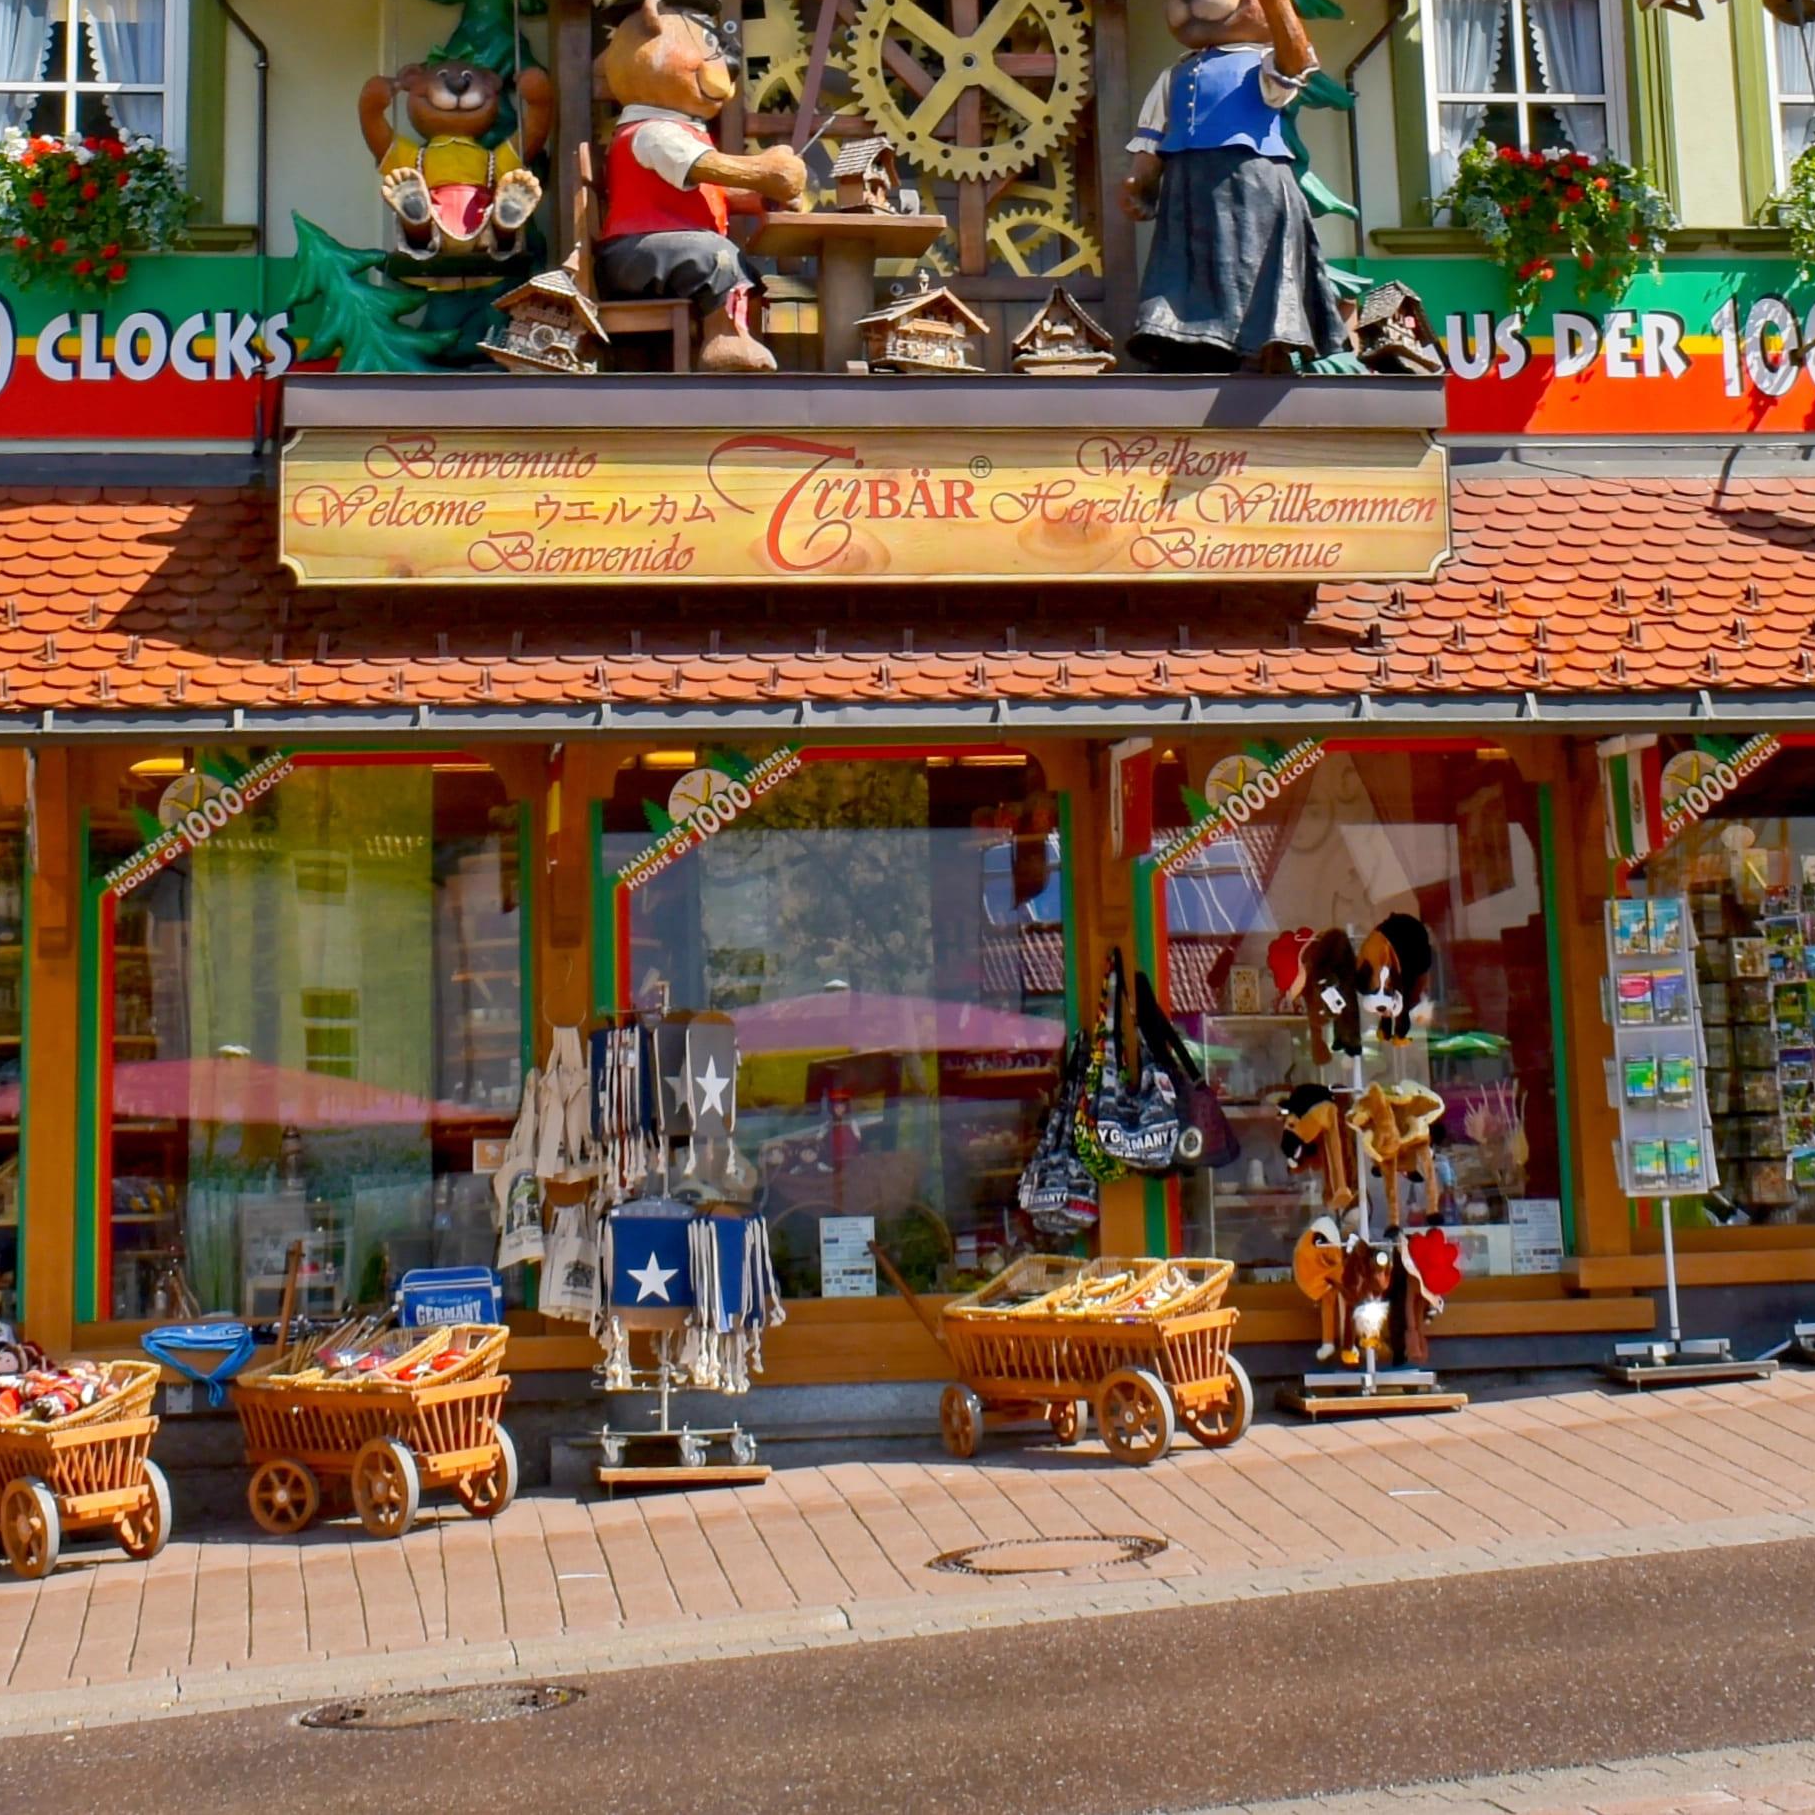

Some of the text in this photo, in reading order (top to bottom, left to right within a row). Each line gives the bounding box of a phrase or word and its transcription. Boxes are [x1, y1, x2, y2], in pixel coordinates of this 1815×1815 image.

[35, 311, 292, 381] CLOCKS
[1444, 312, 1527, 380] US
[1552, 312, 1687, 379] DER
[364, 434, 598, 480] Benvenuto
[1076, 435, 1248, 478] Welkom
[292, 484, 486, 528] Welcome
[990, 478, 1436, 525] Herzlich Willkommen
[467, 530, 695, 574] Bienvenido
[1129, 526, 1343, 570] Bienvenue
[104, 751, 283, 884] HAUS DER 1000 UHREN
[617, 746, 792, 879] HAUS DER 1000 UHREN
[1154, 737, 1316, 866] HAUS DER 1000 UHREN
[1162, 746, 1326, 878] HOUSE OF CLOCKS
[1669, 739, 1782, 832] OF CLOCKS
[1678, 762, 1739, 821] 1000
[113, 761, 295, 897] HOUSE OF CLOCKS
[626, 756, 802, 890] HOUSE OF CLOCKS
[416, 1299, 482, 1326] GERMANY
